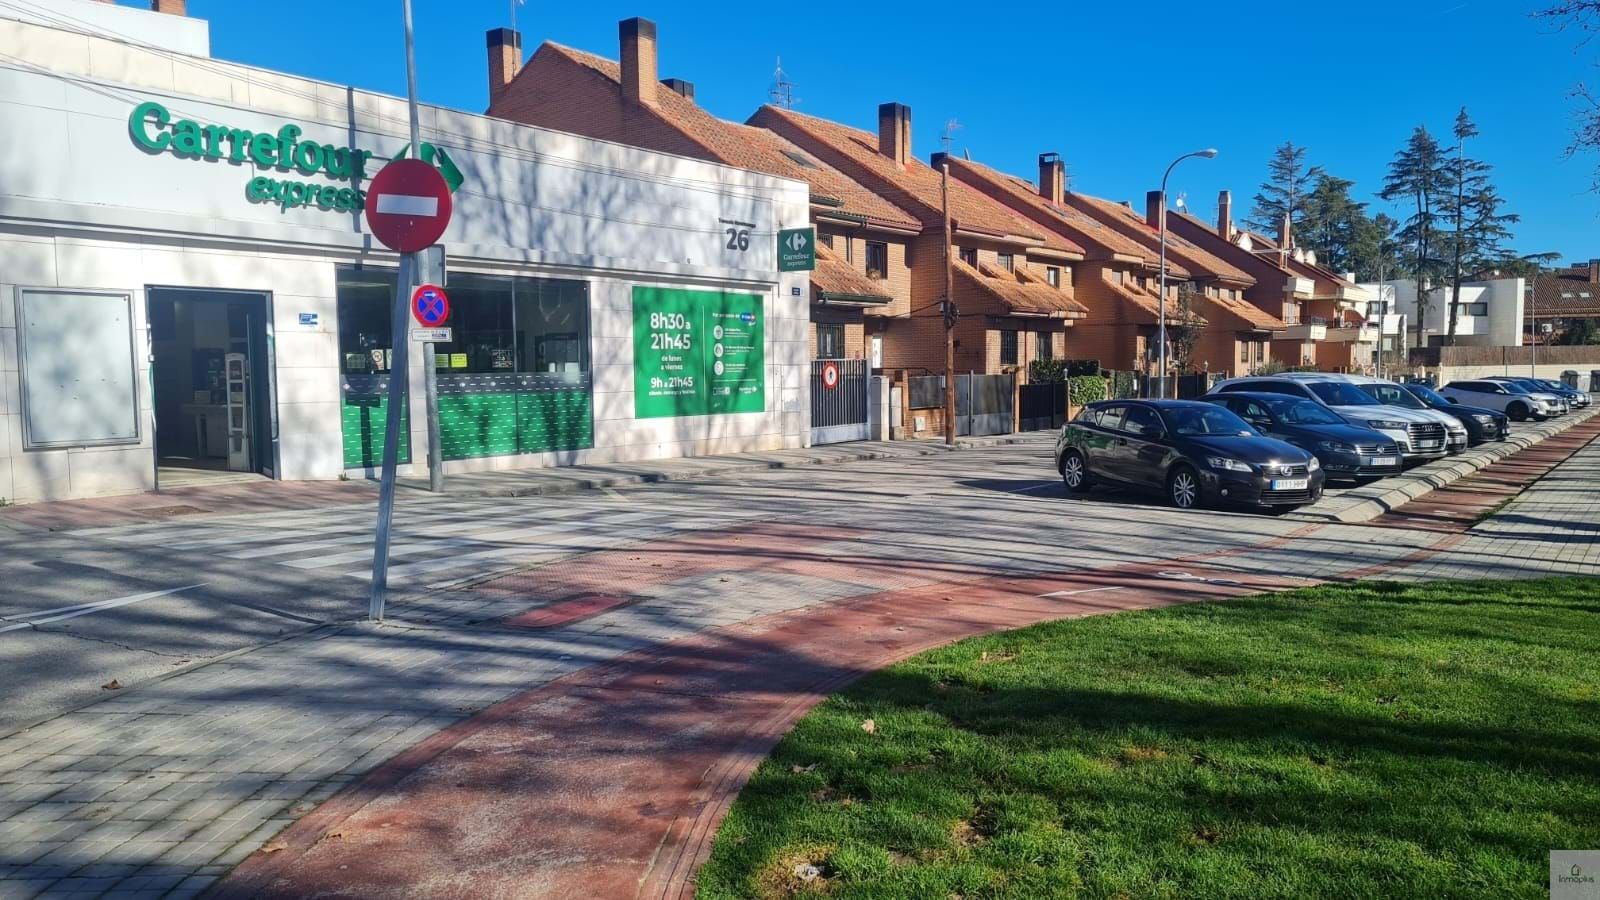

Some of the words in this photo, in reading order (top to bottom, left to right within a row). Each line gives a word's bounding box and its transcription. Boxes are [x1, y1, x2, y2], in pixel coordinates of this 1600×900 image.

[129, 102, 372, 178] Carrefour
[247, 176, 367, 213] express
[726, 228, 749, 251] 26
[650, 312, 684, 329] 8h30
[685, 321, 691, 330] a
[651, 333, 691, 350] 21h45
[651, 377, 663, 388] 9h
[669, 377, 693, 388] 21h45
